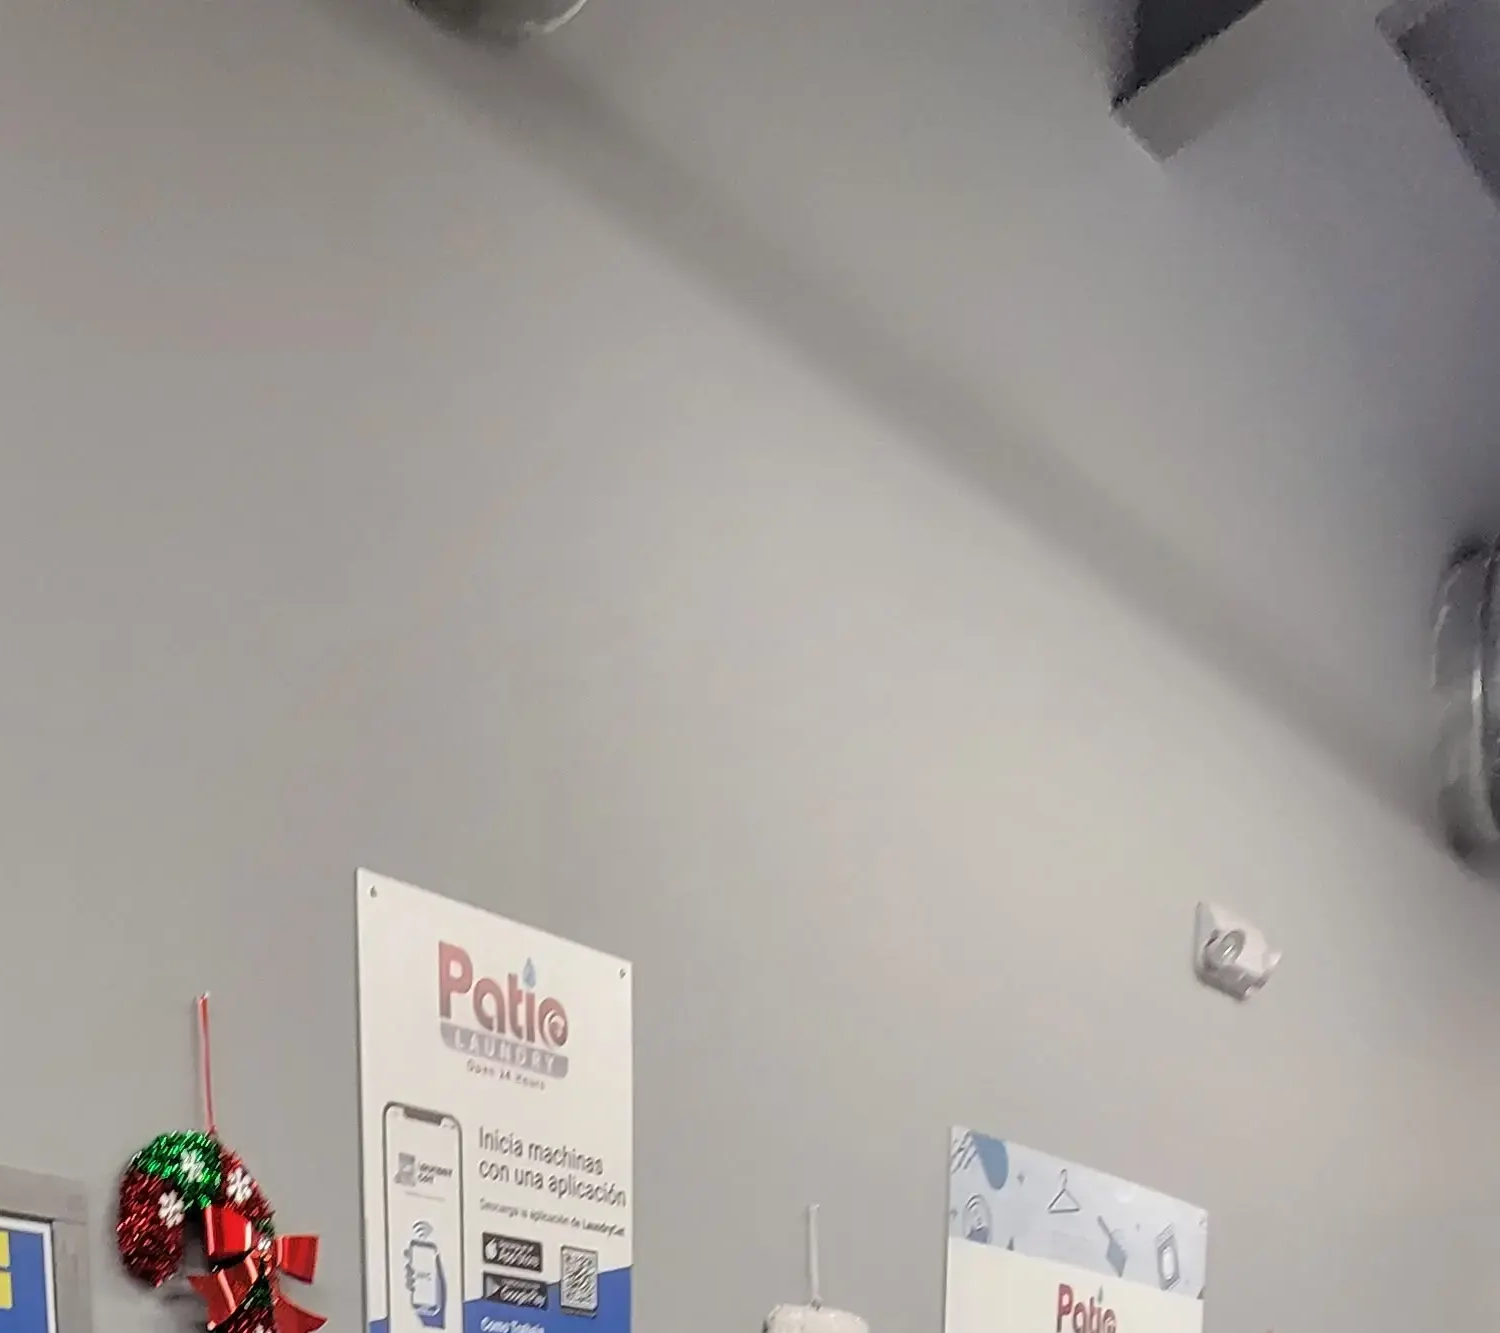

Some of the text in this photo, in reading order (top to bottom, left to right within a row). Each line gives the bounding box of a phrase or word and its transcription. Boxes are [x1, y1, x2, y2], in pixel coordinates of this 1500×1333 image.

[439, 940, 568, 1046] Patio
[455, 1028, 555, 1072] LAUNDRY
[480, 1126, 523, 1157] Inicia
[479, 1160, 509, 1182] con
[515, 1168, 543, 1189] una
[549, 1174, 626, 1207] aplicación
